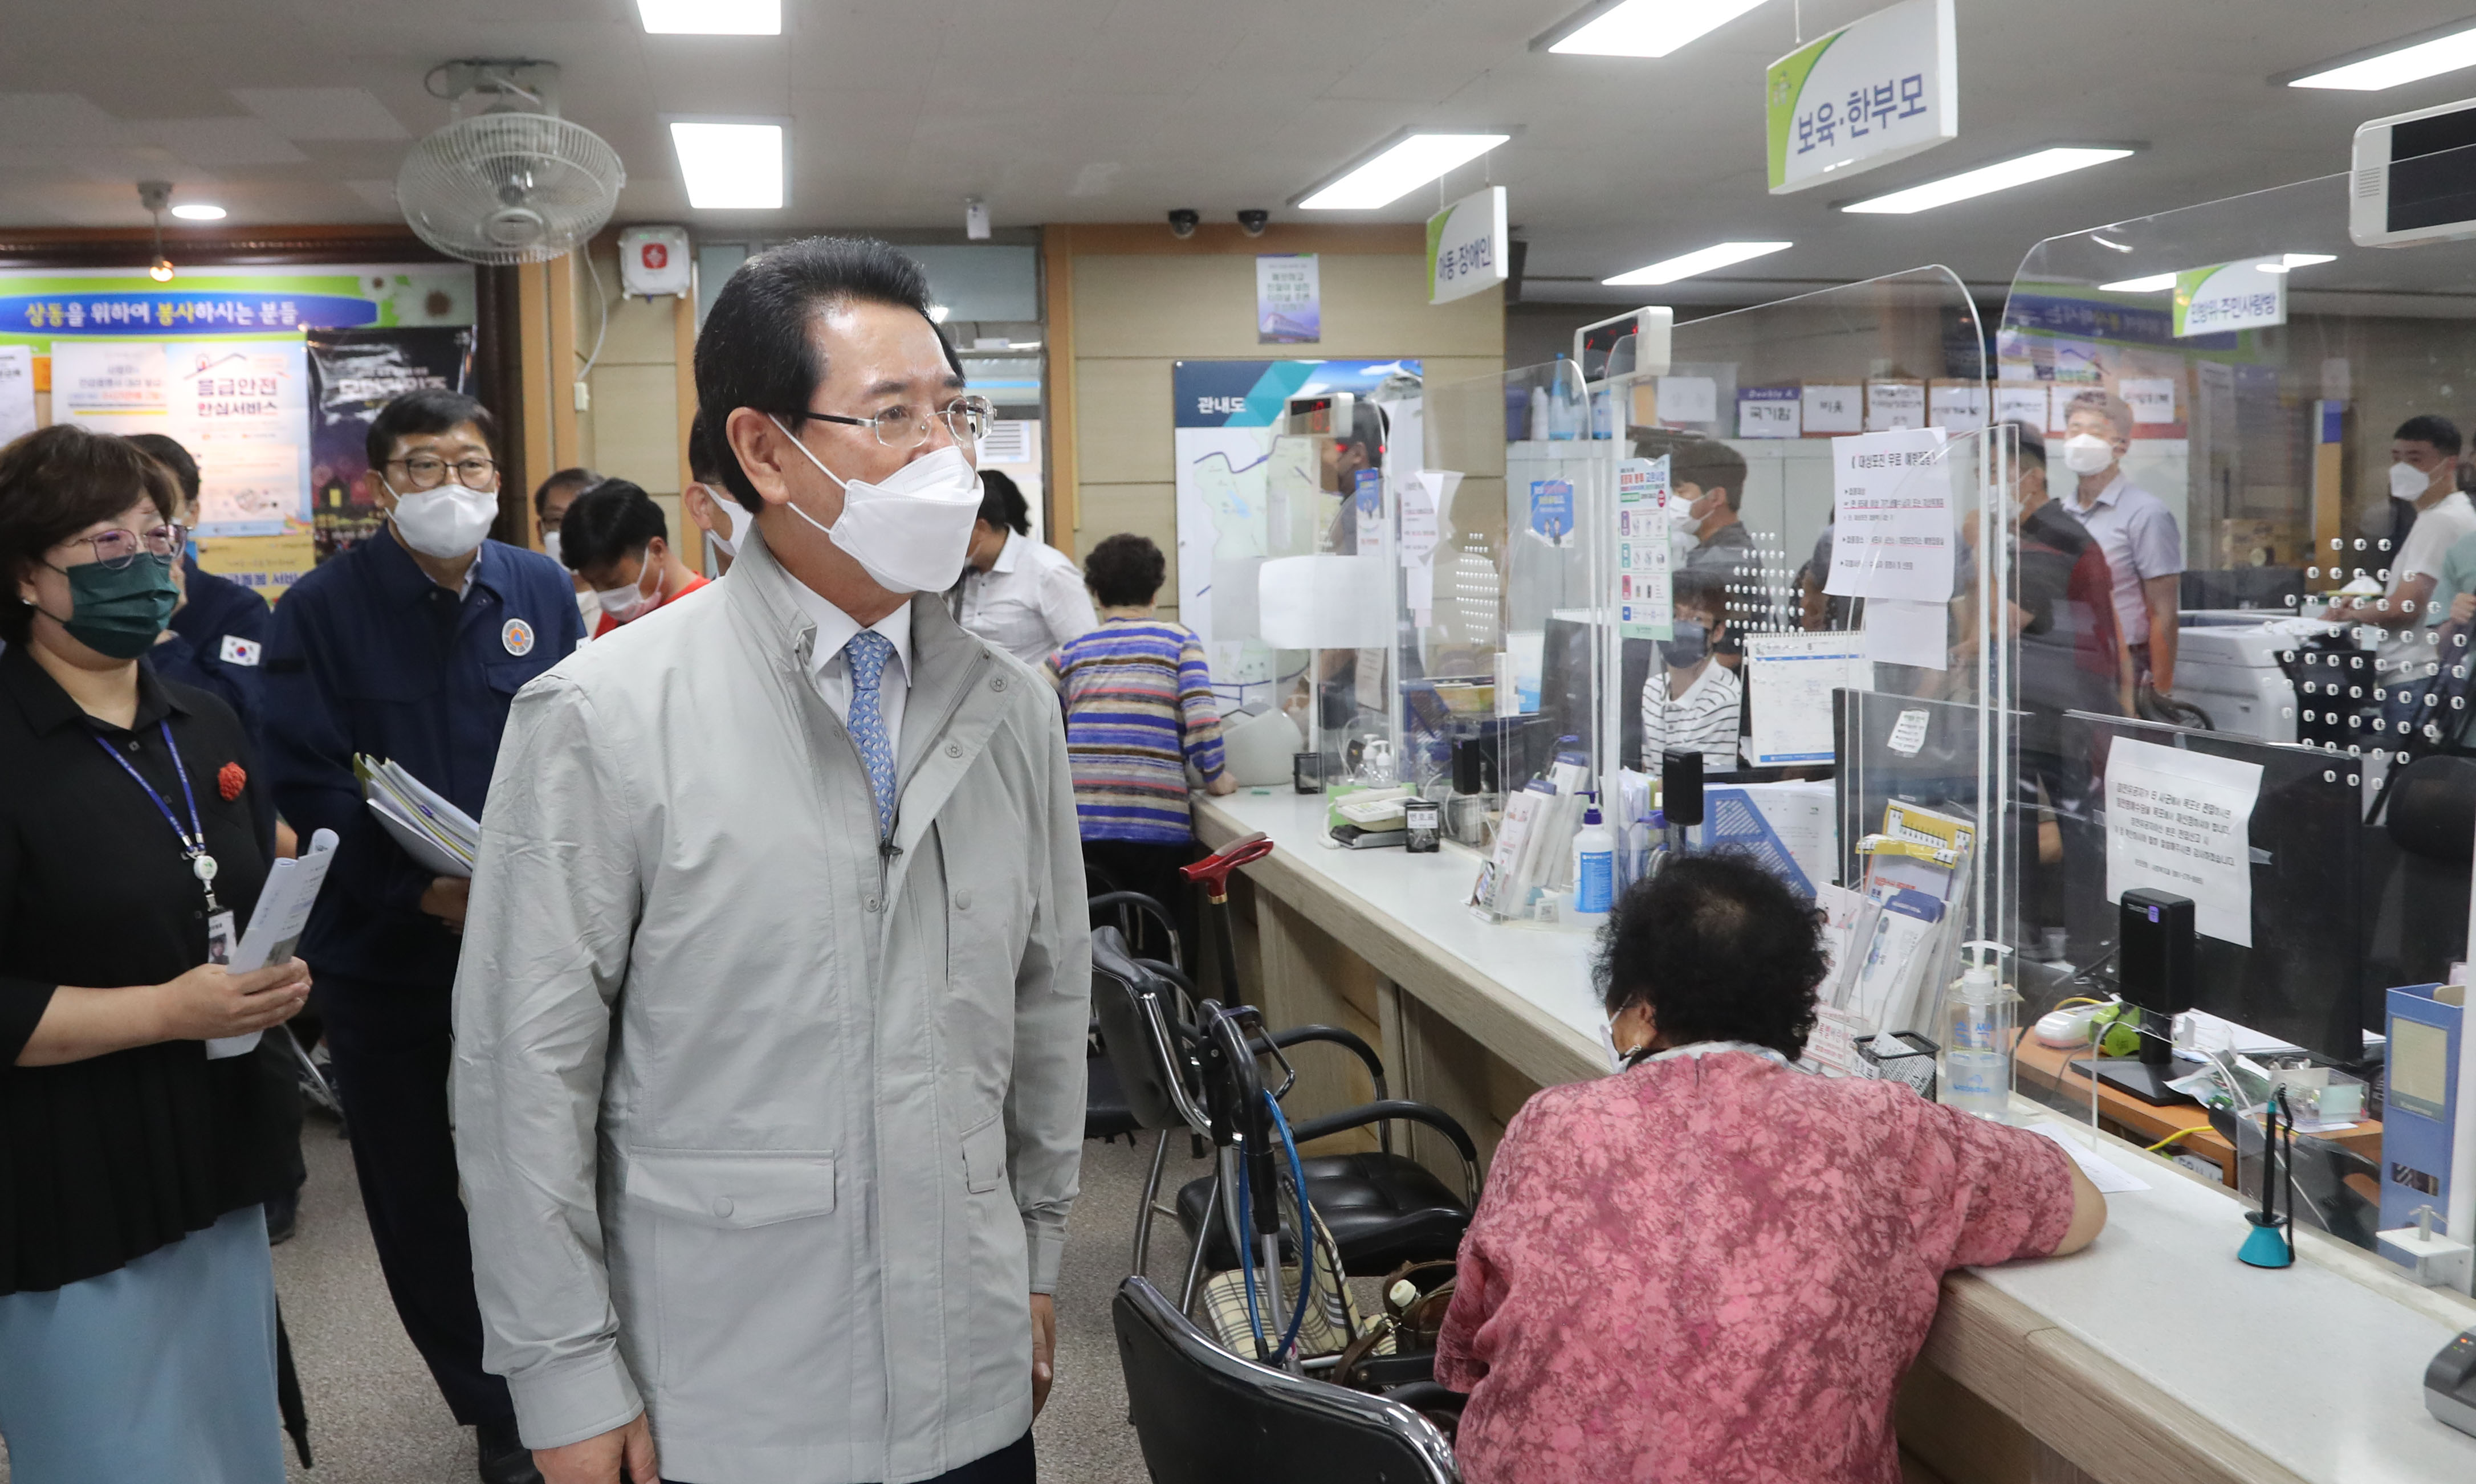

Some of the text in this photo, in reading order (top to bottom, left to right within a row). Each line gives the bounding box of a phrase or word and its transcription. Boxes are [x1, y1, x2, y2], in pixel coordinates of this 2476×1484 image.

[1797, 74, 1927, 154] 보육·한부모
[26, 301, 297, 327] 상동을 위하여 봉사하시는 분들
[198, 400, 278, 416] 안심서비스
[1198, 397, 1246, 414] 관내도
